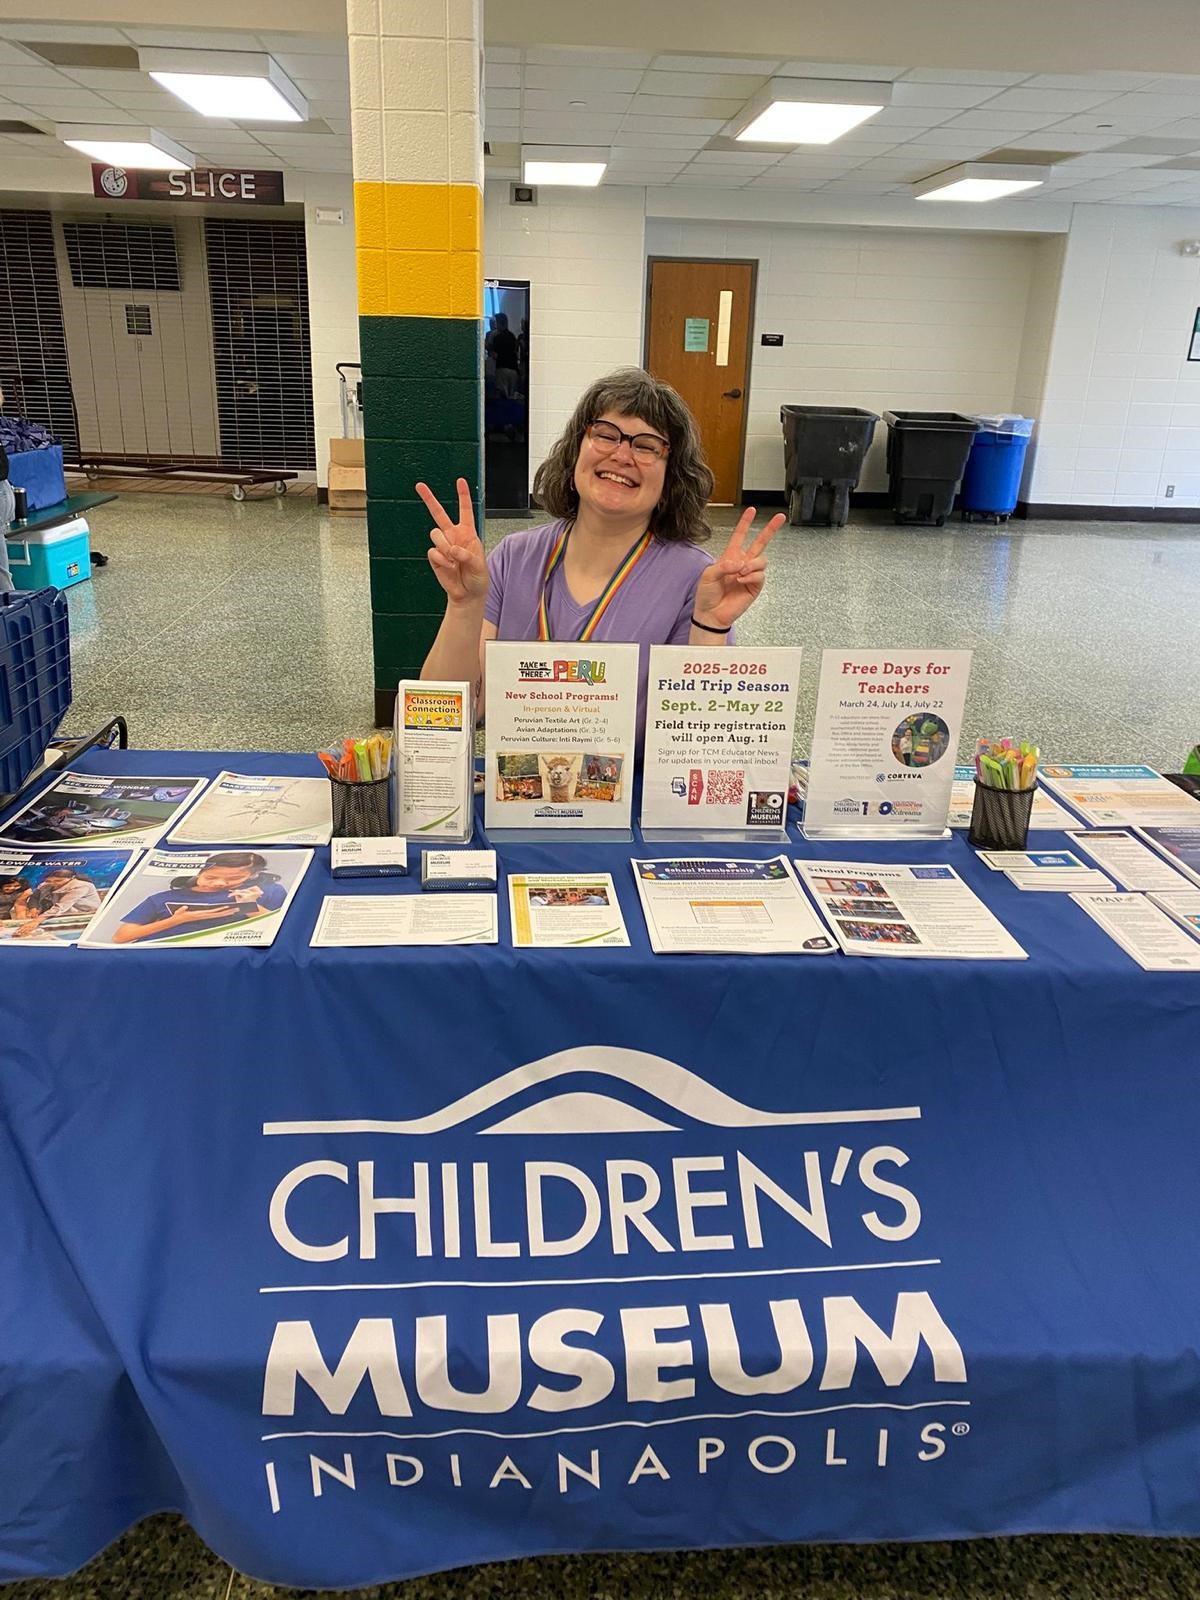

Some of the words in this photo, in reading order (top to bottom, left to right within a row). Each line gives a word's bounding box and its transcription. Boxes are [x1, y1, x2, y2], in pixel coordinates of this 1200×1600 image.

[168, 170, 256, 199] SLICE
[519, 661, 539, 669] TAKE
[683, 663, 767, 675] 2025-2026
[842, 662, 878, 674] Free
[882, 662, 921, 678] Days
[926, 662, 951, 675] for
[520, 670, 544, 678] THERE
[552, 660, 606, 686] PERU
[658, 679, 695, 691] Field
[700, 679, 733, 694] Trip
[737, 680, 790, 692] Season
[858, 681, 930, 694] Teachers
[411, 696, 456, 706] Classroom
[505, 692, 527, 700] New
[529, 692, 563, 701] School
[565, 693, 619, 703] Programs!
[406, 704, 460, 714] Connections
[523, 705, 562, 714] In-person
[661, 700, 702, 714] Sept.
[764, 701, 784, 713] 22
[839, 700, 865, 708] March
[866, 700, 880, 709] 24,
[881, 700, 898, 709] July
[900, 701, 912, 709] 14,
[914, 701, 931, 709] July
[536, 726, 578, 735] Adaptations
[655, 720, 685, 730] Field
[687, 720, 711, 732] trip
[713, 721, 786, 732] registration
[671, 733, 693, 742] will
[696, 734, 724, 744] open
[727, 734, 755, 745] Aug.
[758, 734, 769, 743] 11
[657, 748, 675, 756] Sign
[671, 757, 703, 765] updates
[690, 773, 699, 801] SCAN
[807, 866, 847, 875] School
[848, 869, 903, 879] Programs
[1089, 896, 1123, 904] MAP
[269, 1145, 921, 1263] CHILDREN'S
[261, 1291, 967, 1418] MUSEUM
